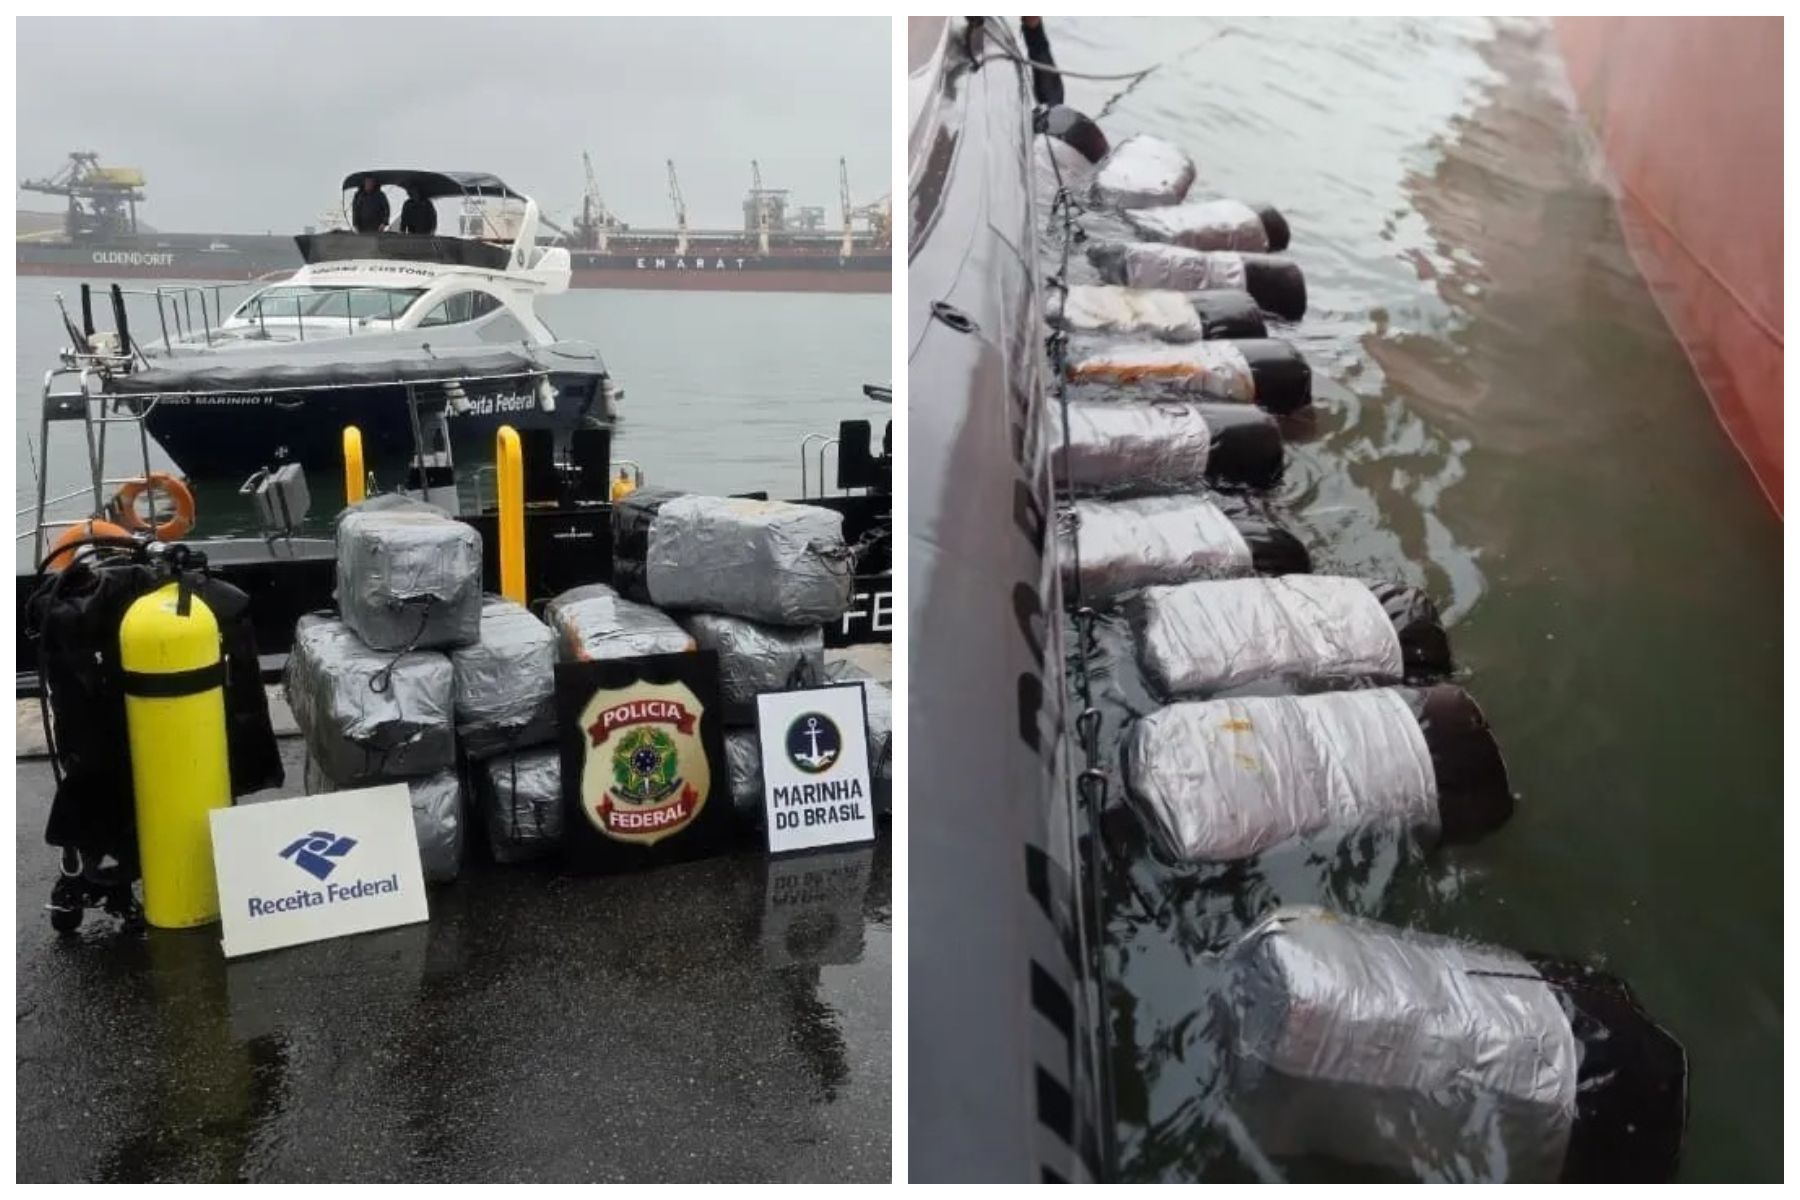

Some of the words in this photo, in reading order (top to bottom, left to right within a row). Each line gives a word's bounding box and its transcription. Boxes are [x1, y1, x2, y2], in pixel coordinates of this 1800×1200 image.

[636, 258, 744, 269] EMARAT
[496, 388, 535, 413] Federal
[603, 702, 682, 727] POLICIA
[773, 779, 863, 808] MARINHA
[609, 804, 687, 828] FEDERAL
[776, 811, 799, 830] DO
[804, 803, 865, 826] BRASIL
[248, 890, 324, 917] Receita
[327, 874, 399, 902] Federal
